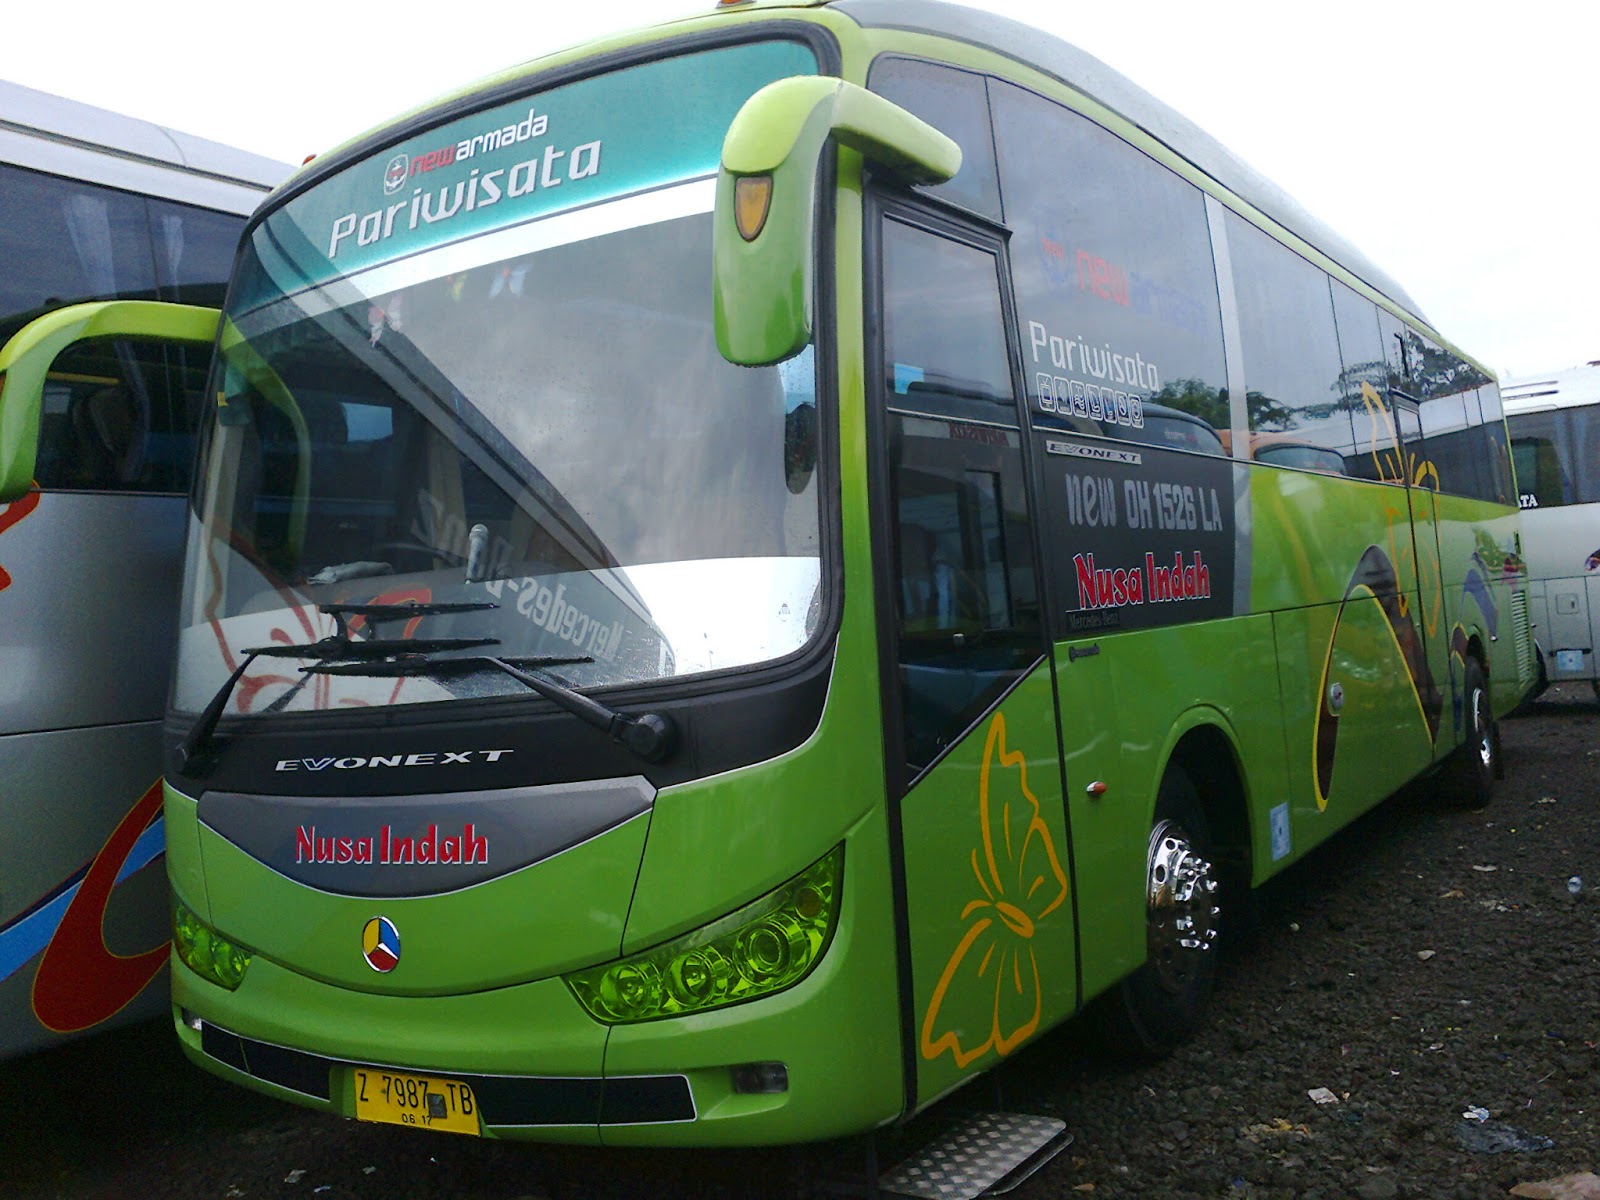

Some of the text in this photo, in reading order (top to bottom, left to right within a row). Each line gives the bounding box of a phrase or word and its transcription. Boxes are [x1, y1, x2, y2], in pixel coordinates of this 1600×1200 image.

[327, 140, 602, 260] Pariwisata
[1029, 320, 1160, 393] Pariwisata
[1050, 442, 1141, 464] EVONEXT
[1153, 482, 1198, 531] 1526
[1199, 486, 1224, 532] LA
[1072, 550, 1211, 611] Nusa Indah
[275, 749, 514, 771] EVONEXT
[295, 823, 488, 865] Nusa Indah
[358, 1073, 473, 1115] Z 7987 TB
[401, 1113, 415, 1125] 06
